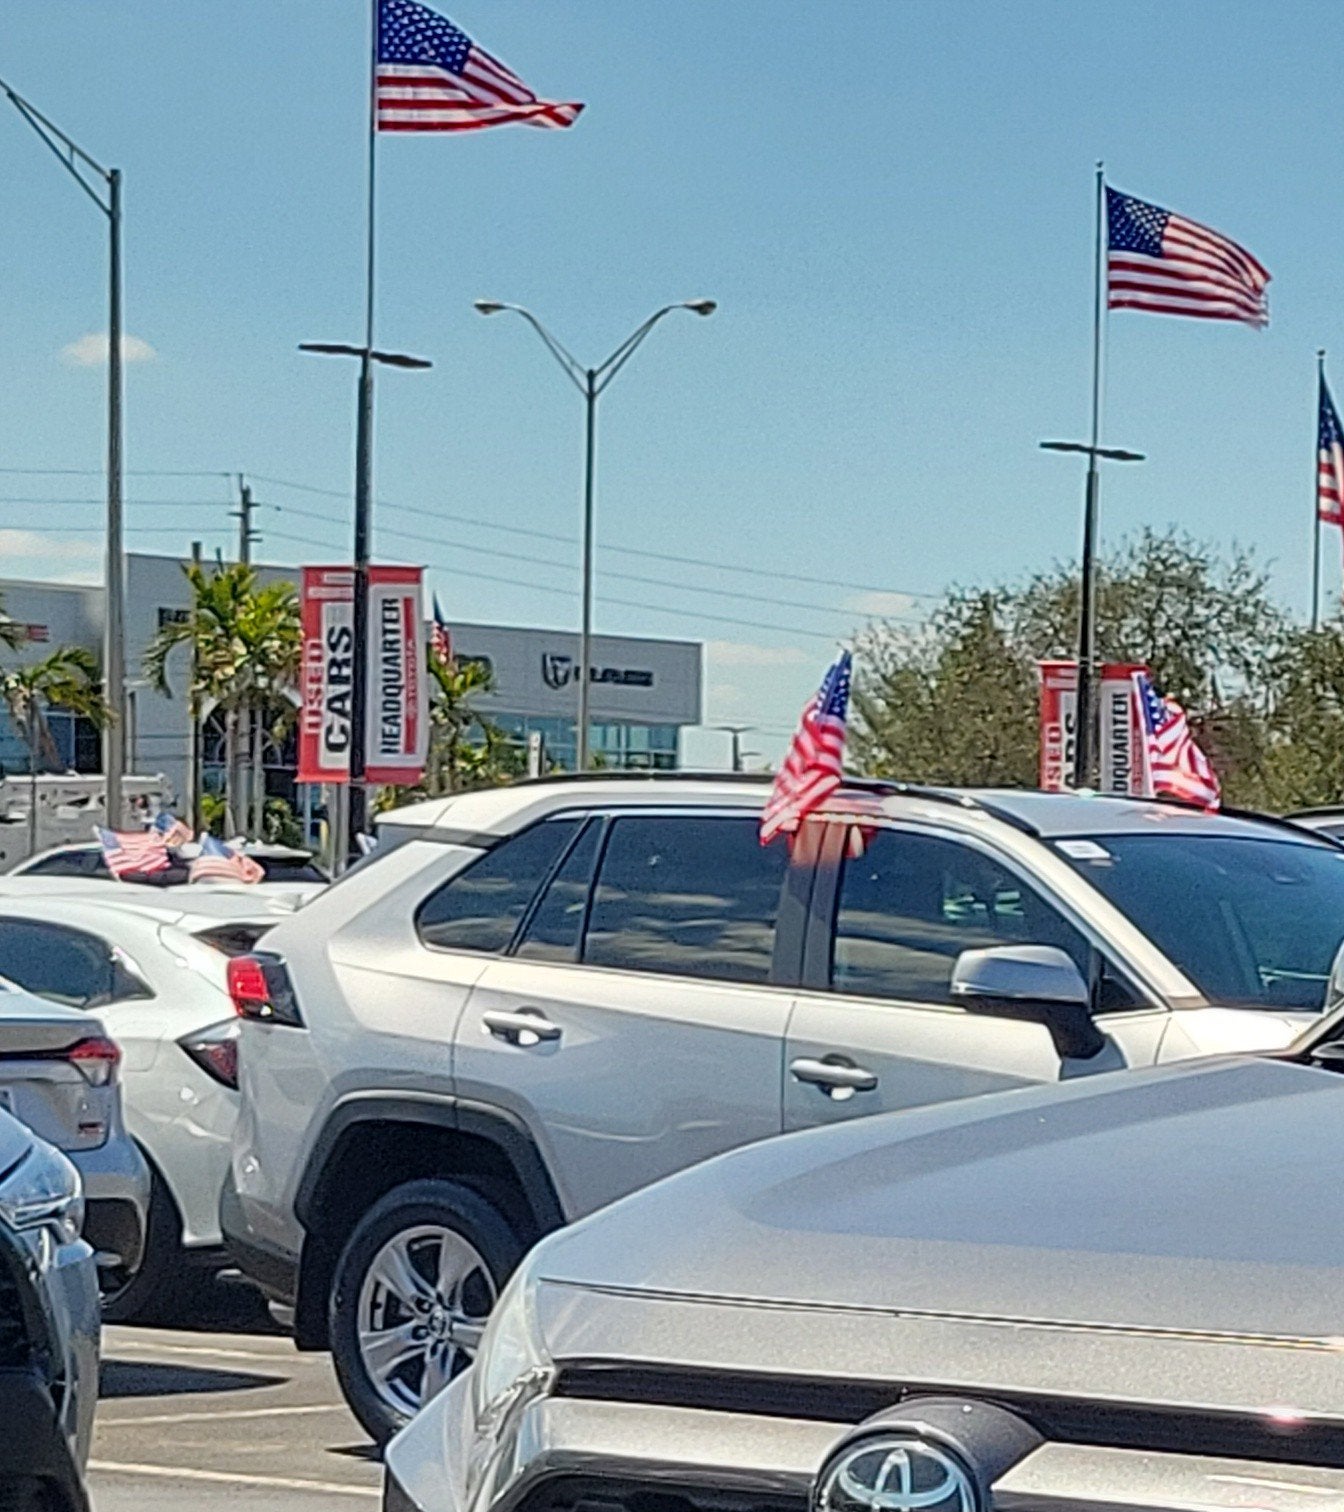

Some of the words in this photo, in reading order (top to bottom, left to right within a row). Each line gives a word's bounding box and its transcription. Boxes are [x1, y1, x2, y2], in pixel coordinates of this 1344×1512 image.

[306, 638, 323, 735] USED
[325, 625, 352, 754] CARS
[381, 597, 404, 755] HEADQUARTER
[1111, 692, 1130, 792] DQUARTER
